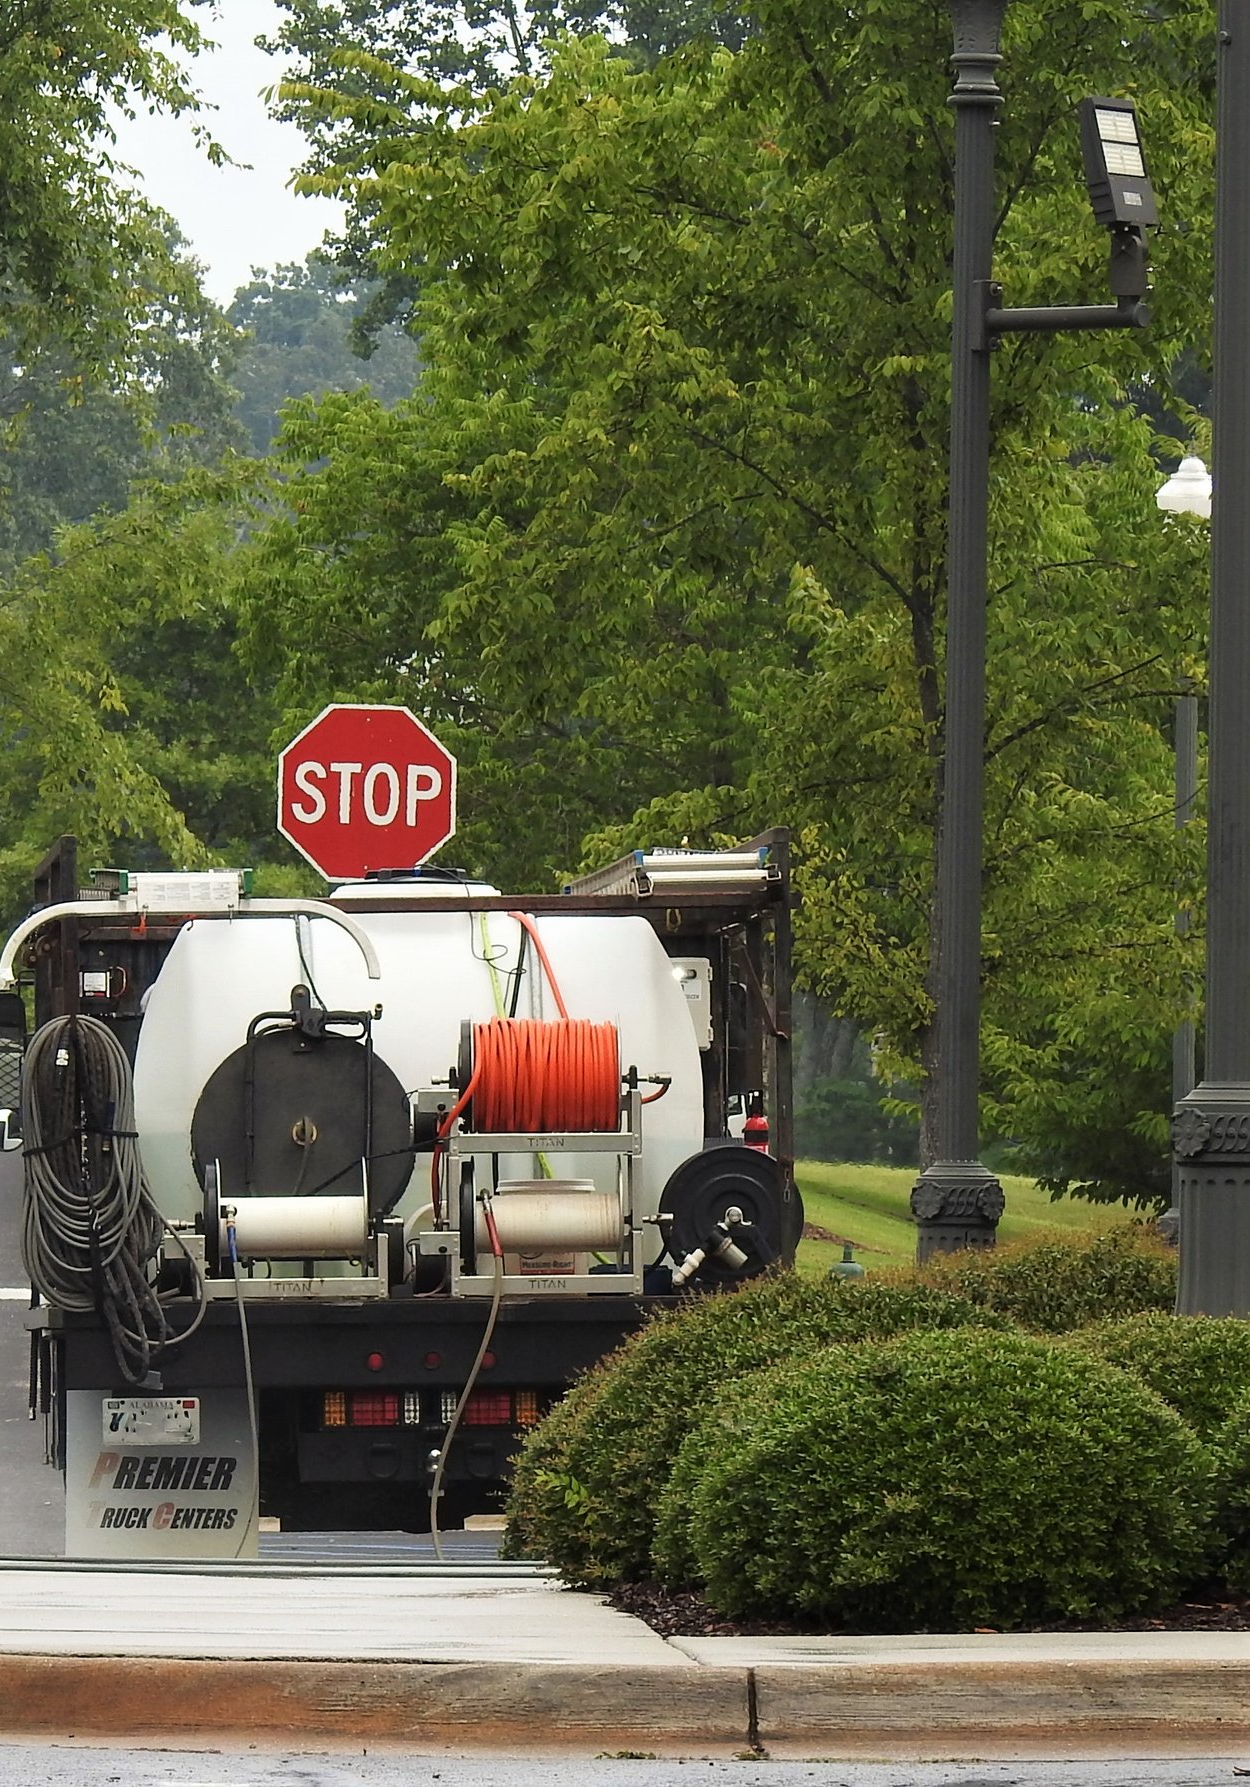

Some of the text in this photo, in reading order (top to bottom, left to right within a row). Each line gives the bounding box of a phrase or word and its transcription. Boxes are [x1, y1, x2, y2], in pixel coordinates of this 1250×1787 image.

[291, 761, 442, 827] STOP
[527, 1137, 565, 1147] TITAN
[273, 1281, 312, 1292] TITAN
[528, 1279, 566, 1289] TITAN
[88, 1452, 237, 1490] PREMIER
[86, 1501, 238, 1530] TRUCK CENTERS
